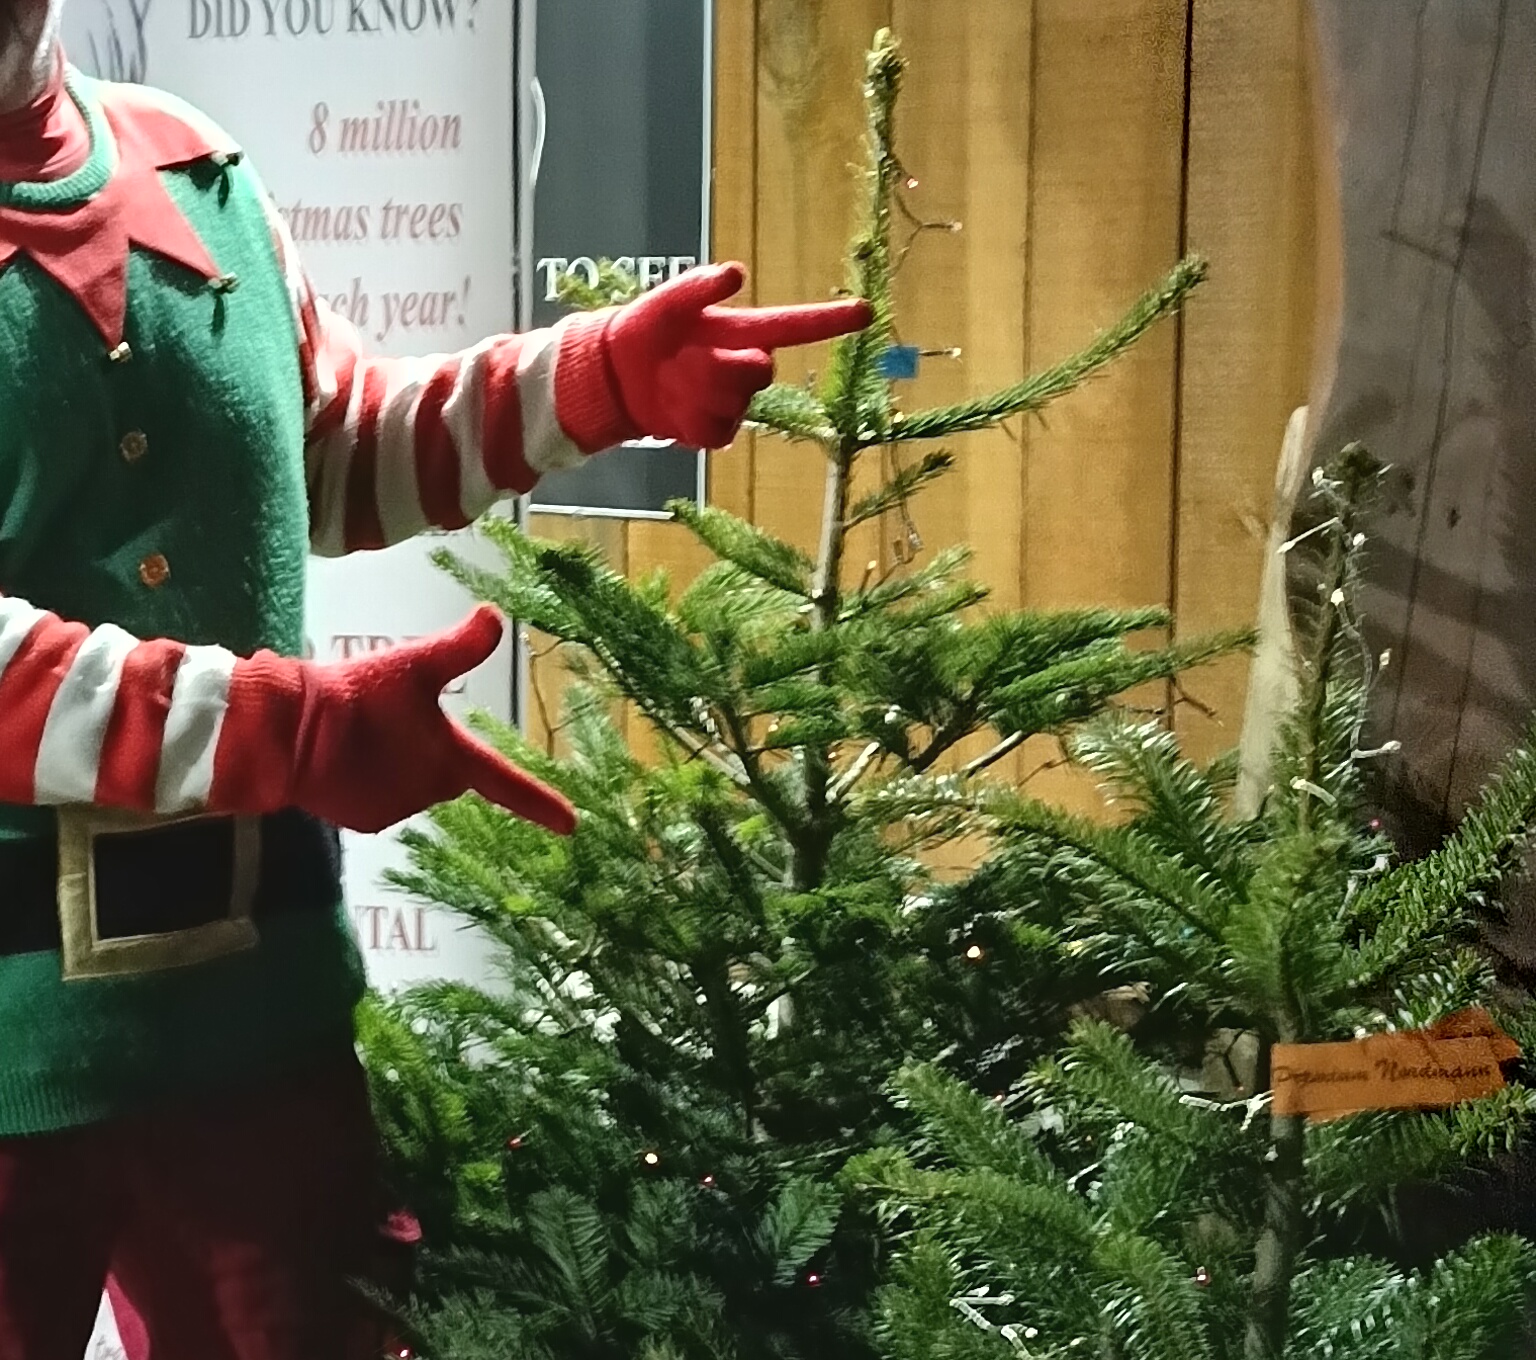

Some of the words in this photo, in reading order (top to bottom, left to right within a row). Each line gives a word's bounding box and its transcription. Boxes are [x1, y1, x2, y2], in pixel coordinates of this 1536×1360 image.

[309, 101, 329, 154] 8
[338, 99, 462, 153] million
[379, 197, 464, 241] trees
[376, 275, 472, 342] year!
[355, 905, 436, 951] TAL
